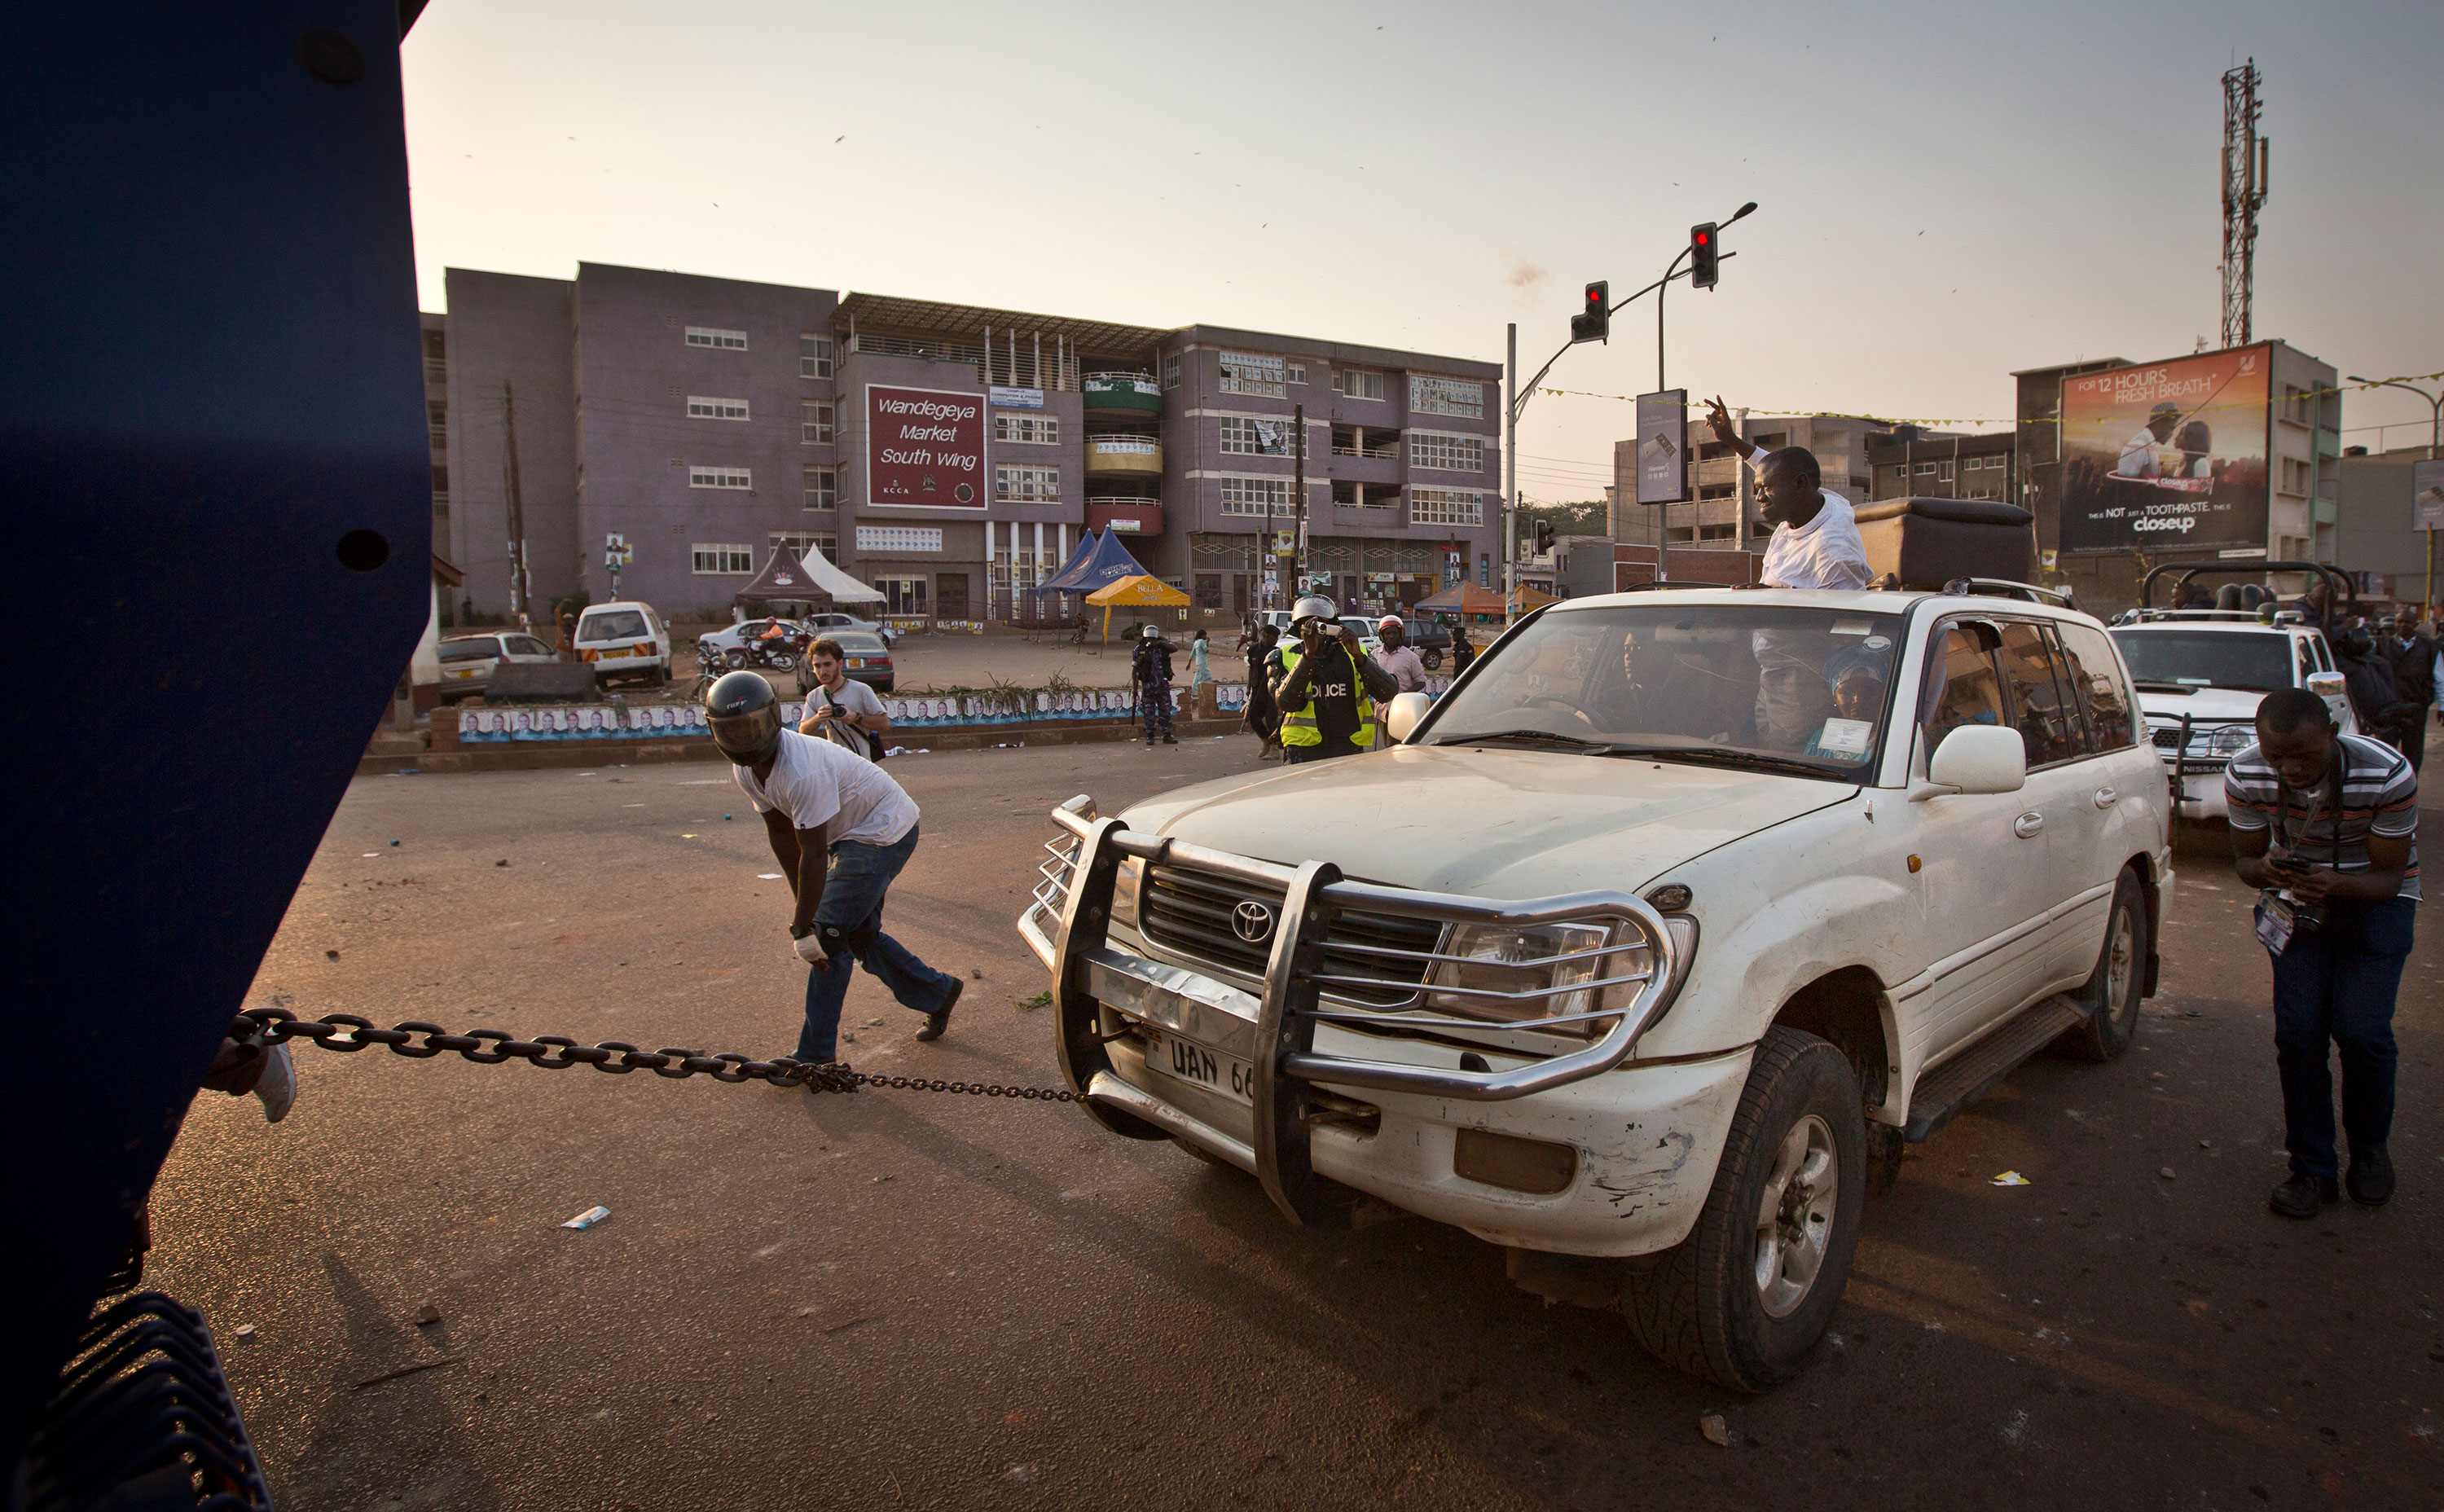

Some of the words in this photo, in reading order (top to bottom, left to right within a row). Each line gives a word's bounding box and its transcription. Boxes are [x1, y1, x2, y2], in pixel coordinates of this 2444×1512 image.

[2078, 381, 2096, 392] FOR
[2098, 378, 2112, 393] 12
[2115, 369, 2167, 389] HOURS
[2115, 385, 2155, 404] FRESH
[878, 398, 976, 422] Wandegeya
[899, 424, 957, 442] Market
[880, 448, 931, 466] South
[2106, 507, 2126, 518] NOT
[2145, 502, 2211, 516] TOOTHPASTE.
[2134, 516, 2196, 534] closeup
[1137, 584, 1163, 593] BELLA
[1171, 1039, 1217, 1085] UAN
